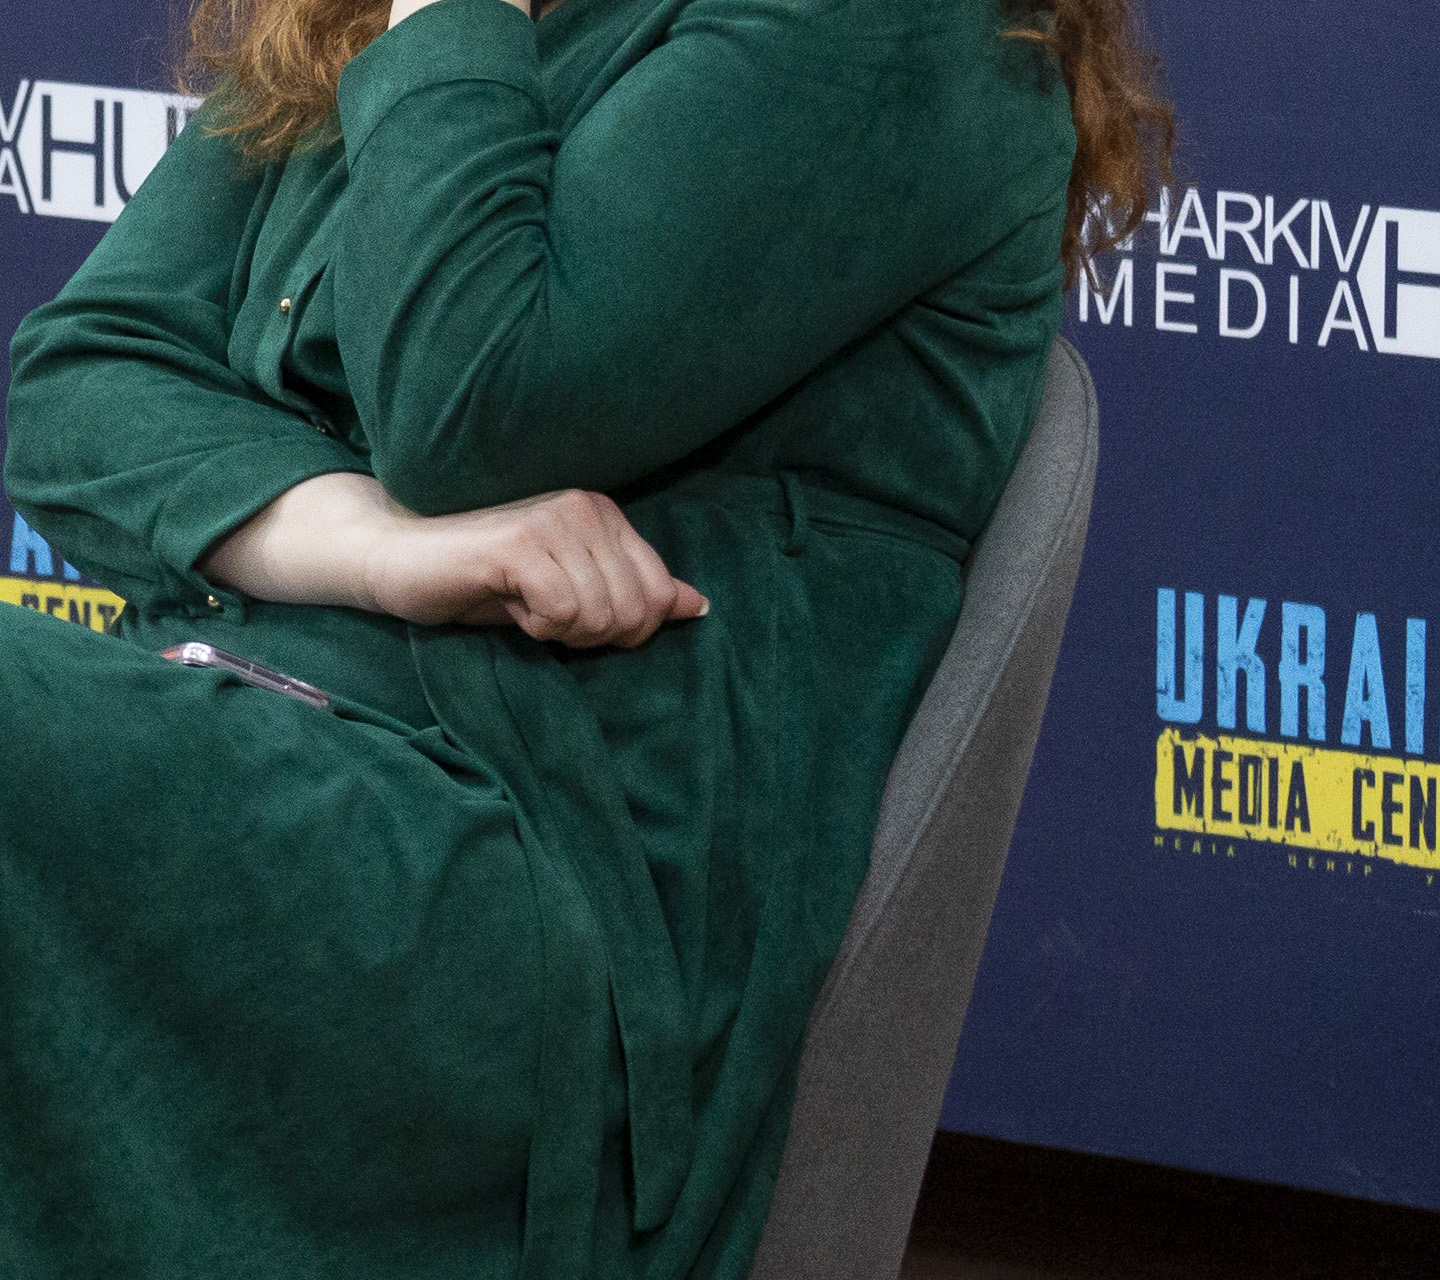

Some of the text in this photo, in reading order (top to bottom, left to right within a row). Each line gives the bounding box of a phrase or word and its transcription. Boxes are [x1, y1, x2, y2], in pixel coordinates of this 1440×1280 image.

[1079, 257, 1370, 352] MEDIA
[1156, 587, 1426, 755] UKRAI
[1173, 743, 1312, 834] MEDIA
